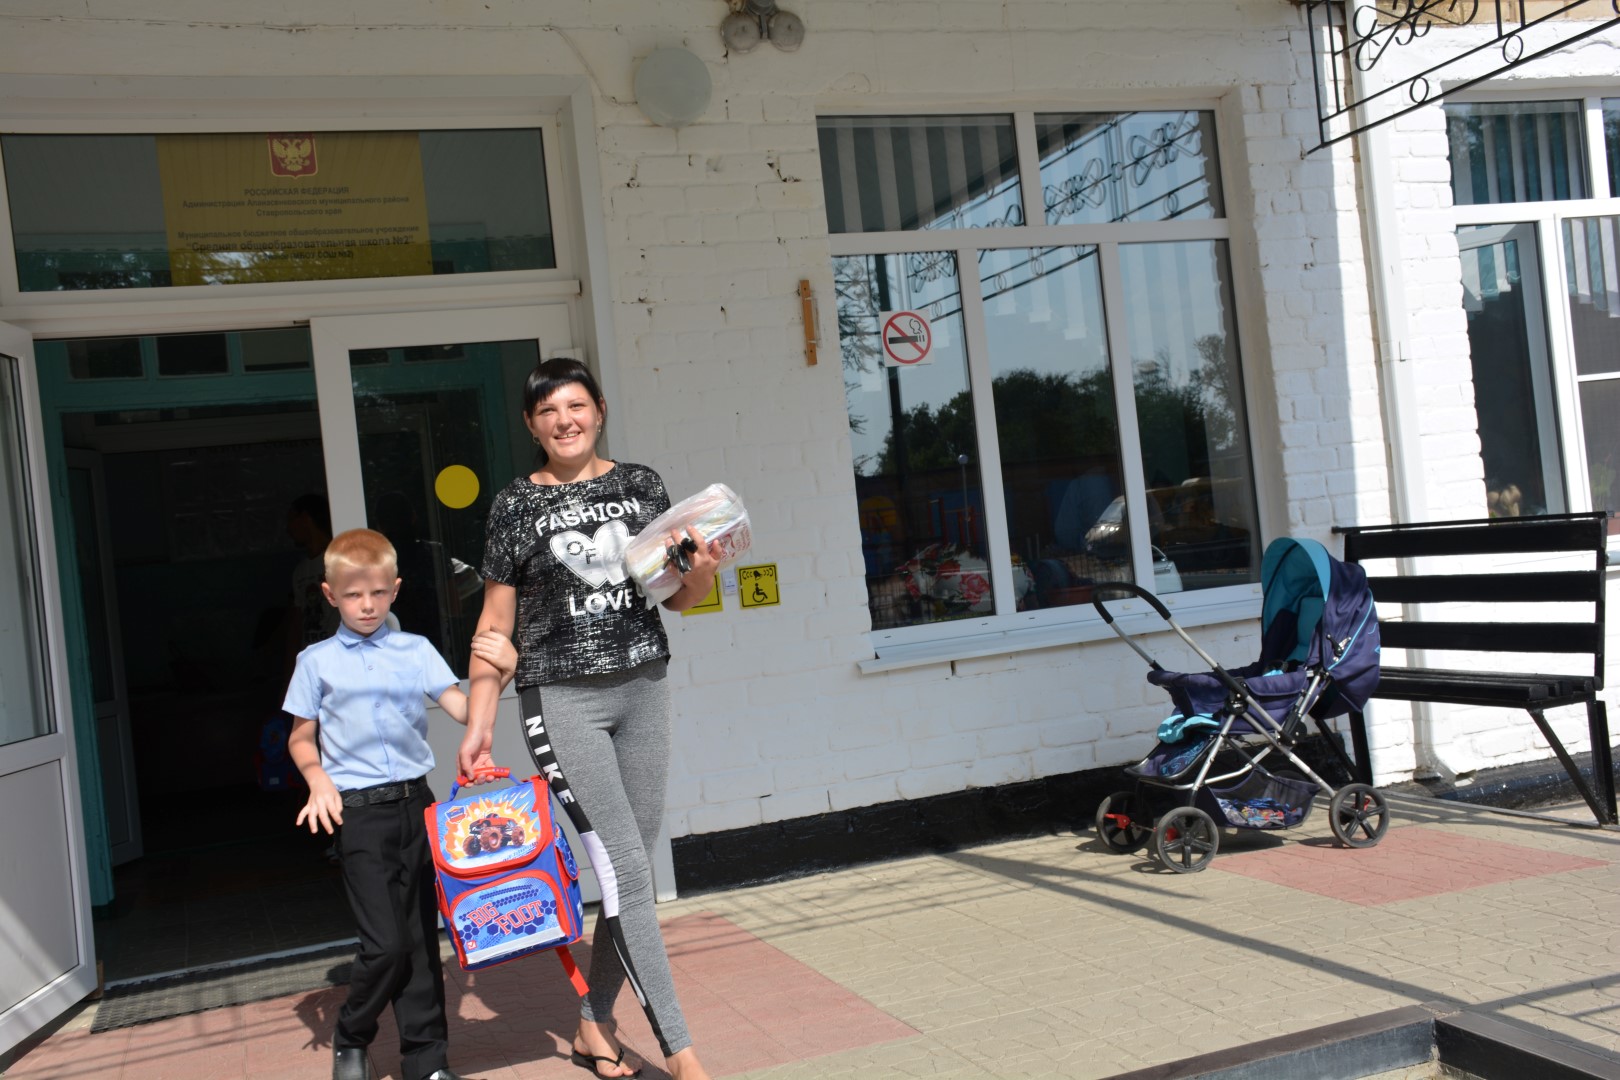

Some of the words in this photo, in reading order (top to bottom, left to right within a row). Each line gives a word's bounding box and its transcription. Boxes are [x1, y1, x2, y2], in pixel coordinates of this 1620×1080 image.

[183, 200, 245, 208] Администрация
[320, 197, 381, 205] муниципального
[244, 186, 299, 196] РОССИЙСКАЯ
[301, 186, 349, 195] ФЕДЕРАЦИЯ
[256, 208, 323, 217] Ставропольского
[178, 230, 240, 240] Муниципальное
[243, 229, 286, 237] бюджетное
[289, 227, 373, 236] общеобразовательное
[375, 225, 419, 234] учреждение
[240, 239, 356, 251] общеобразовательная
[359, 238, 391, 247] школа
[535, 497, 640, 537] FASHION
[567, 541, 596, 564] OF
[568, 588, 633, 616] LOVE
[525, 715, 575, 806] NIKE
[466, 902, 500, 928] BIG
[493, 900, 545, 935] FOOT
